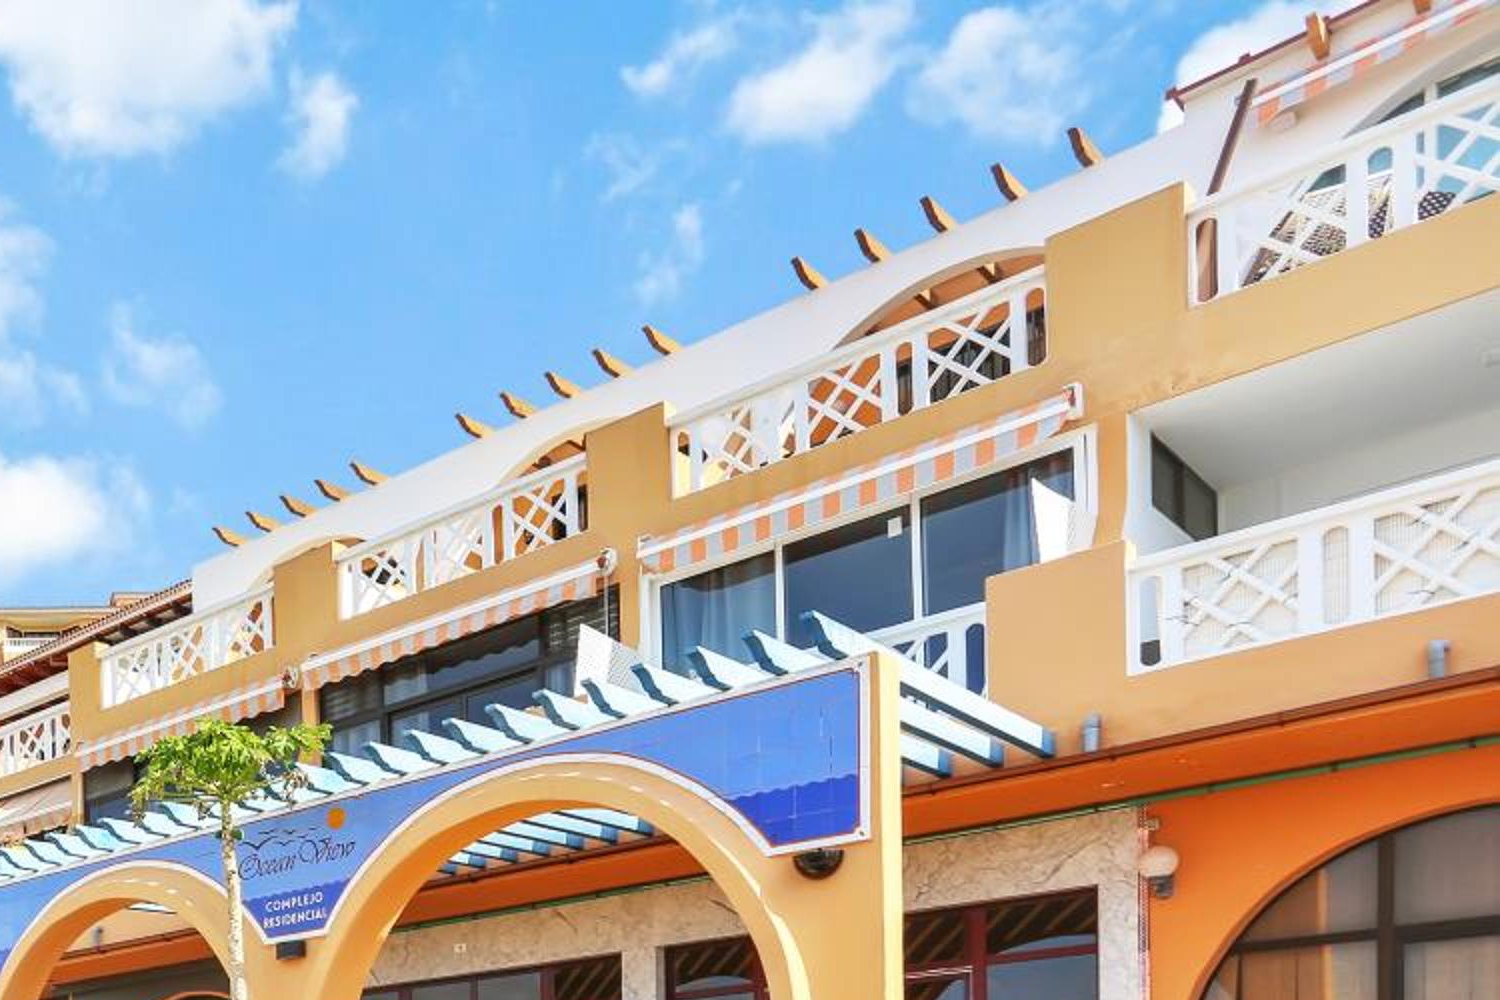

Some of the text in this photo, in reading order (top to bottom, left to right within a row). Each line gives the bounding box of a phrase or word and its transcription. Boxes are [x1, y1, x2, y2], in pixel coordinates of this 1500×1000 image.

[238, 837, 356, 880] Ocean View
[265, 891, 324, 913] COMPLEJO
[263, 907, 327, 928] RESIDENCIAL
